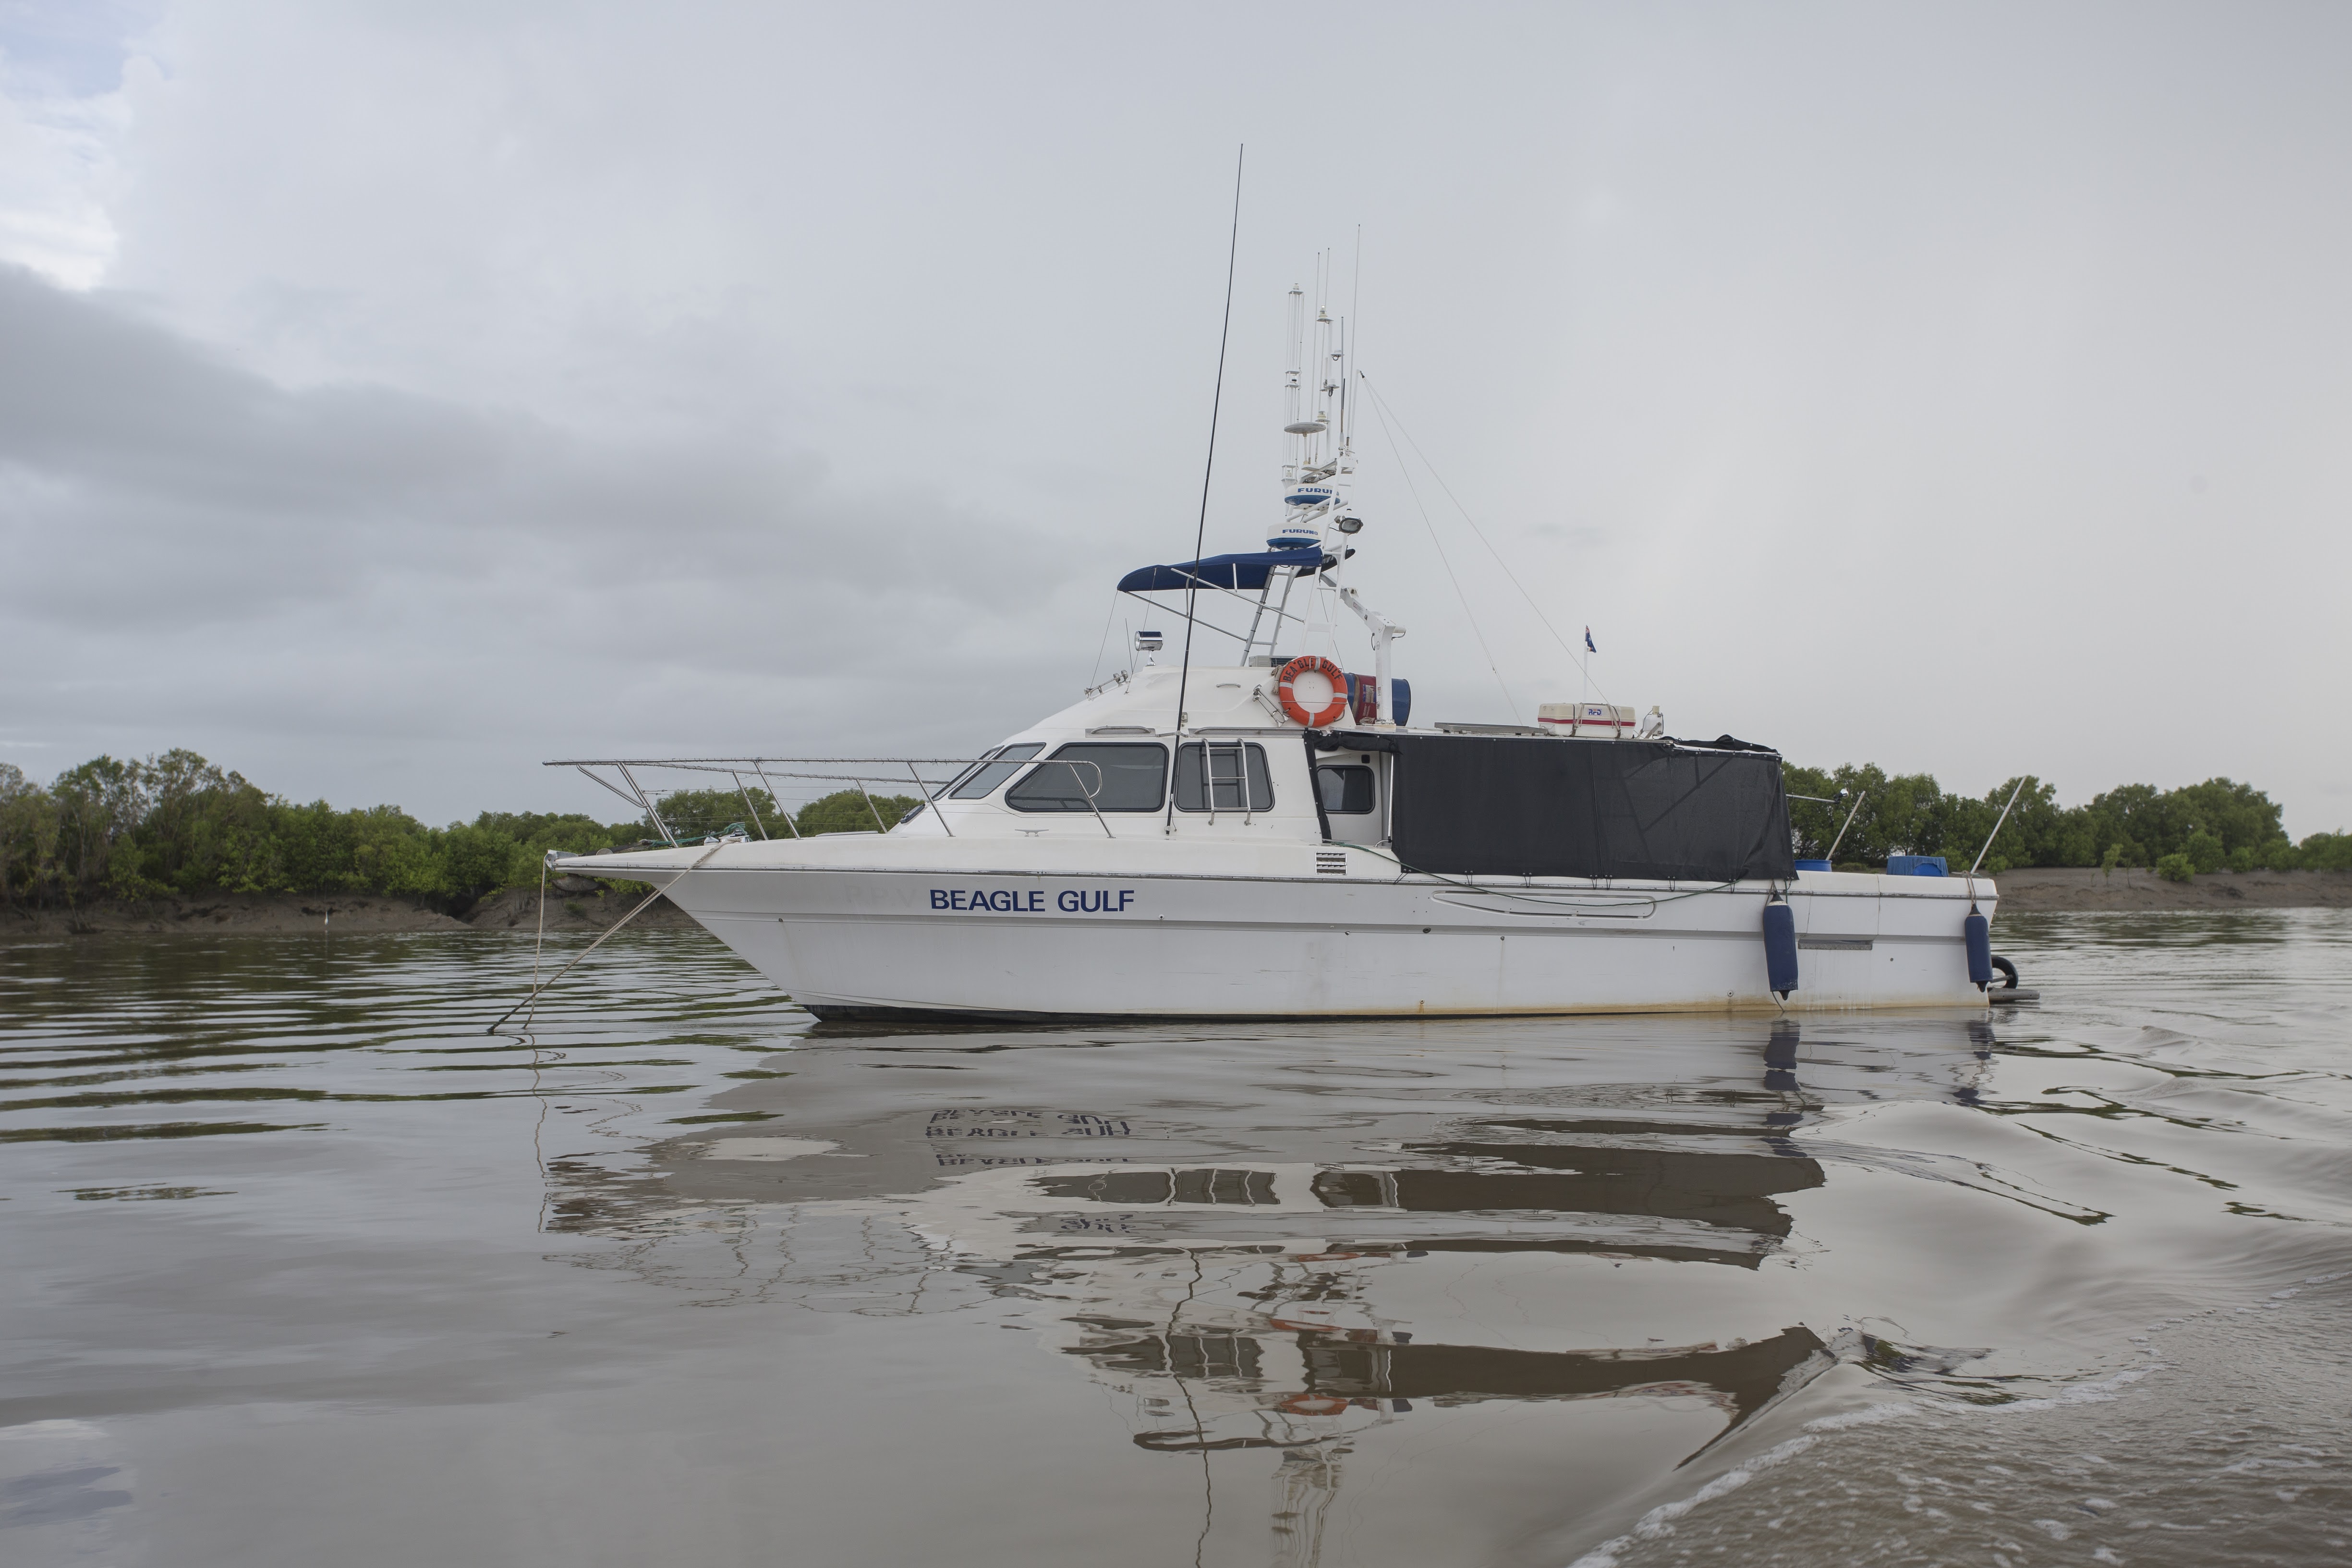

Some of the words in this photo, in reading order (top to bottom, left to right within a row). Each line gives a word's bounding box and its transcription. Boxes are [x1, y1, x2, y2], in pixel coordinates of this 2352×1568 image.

[1283, 657, 1314, 682] BEAGLE
[1322, 660, 1343, 680] GULF
[930, 889, 1045, 912] BEAGLE
[1057, 890, 1134, 912] GULF
